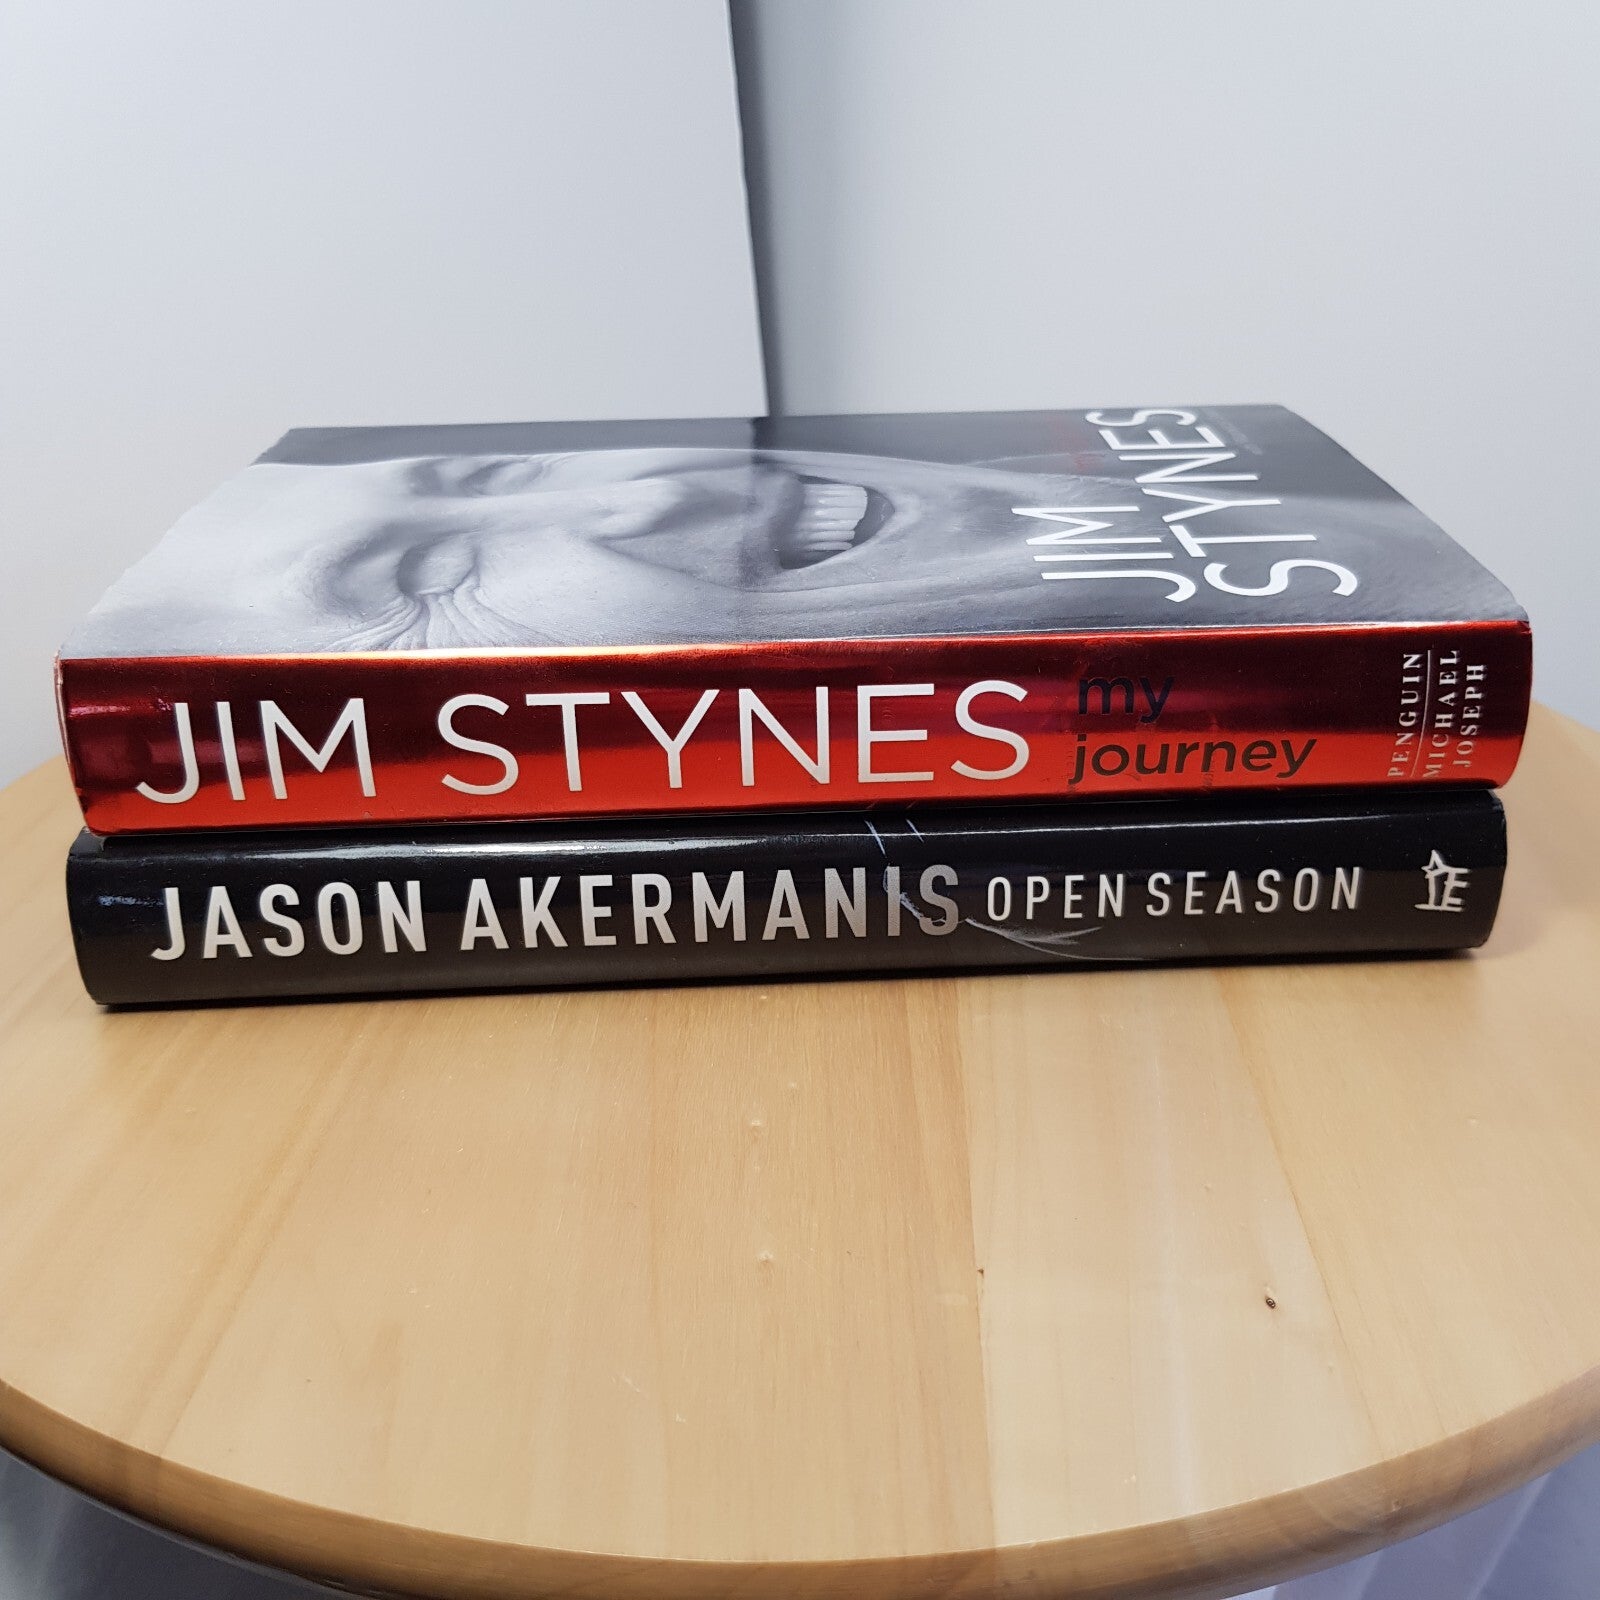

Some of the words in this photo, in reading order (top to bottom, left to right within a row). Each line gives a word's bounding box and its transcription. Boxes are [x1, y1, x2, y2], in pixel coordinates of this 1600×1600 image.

[1011, 506, 1197, 602] JIM
[1084, 408, 1358, 597] STYNES
[136, 697, 377, 804] JIM
[437, 679, 1030, 796] STYNES
[1077, 676, 1175, 724] my
[1387, 653, 1422, 777] PENGUIN
[1422, 650, 1459, 778] MICHAEL
[1452, 664, 1486, 768] JOSEPH
[1068, 733, 1317, 785] journey
[150, 880, 426, 961] JASON
[460, 864, 959, 951] AKERMANIS
[986, 873, 1125, 922] OPEN
[1146, 866, 1361, 916] SEASON
